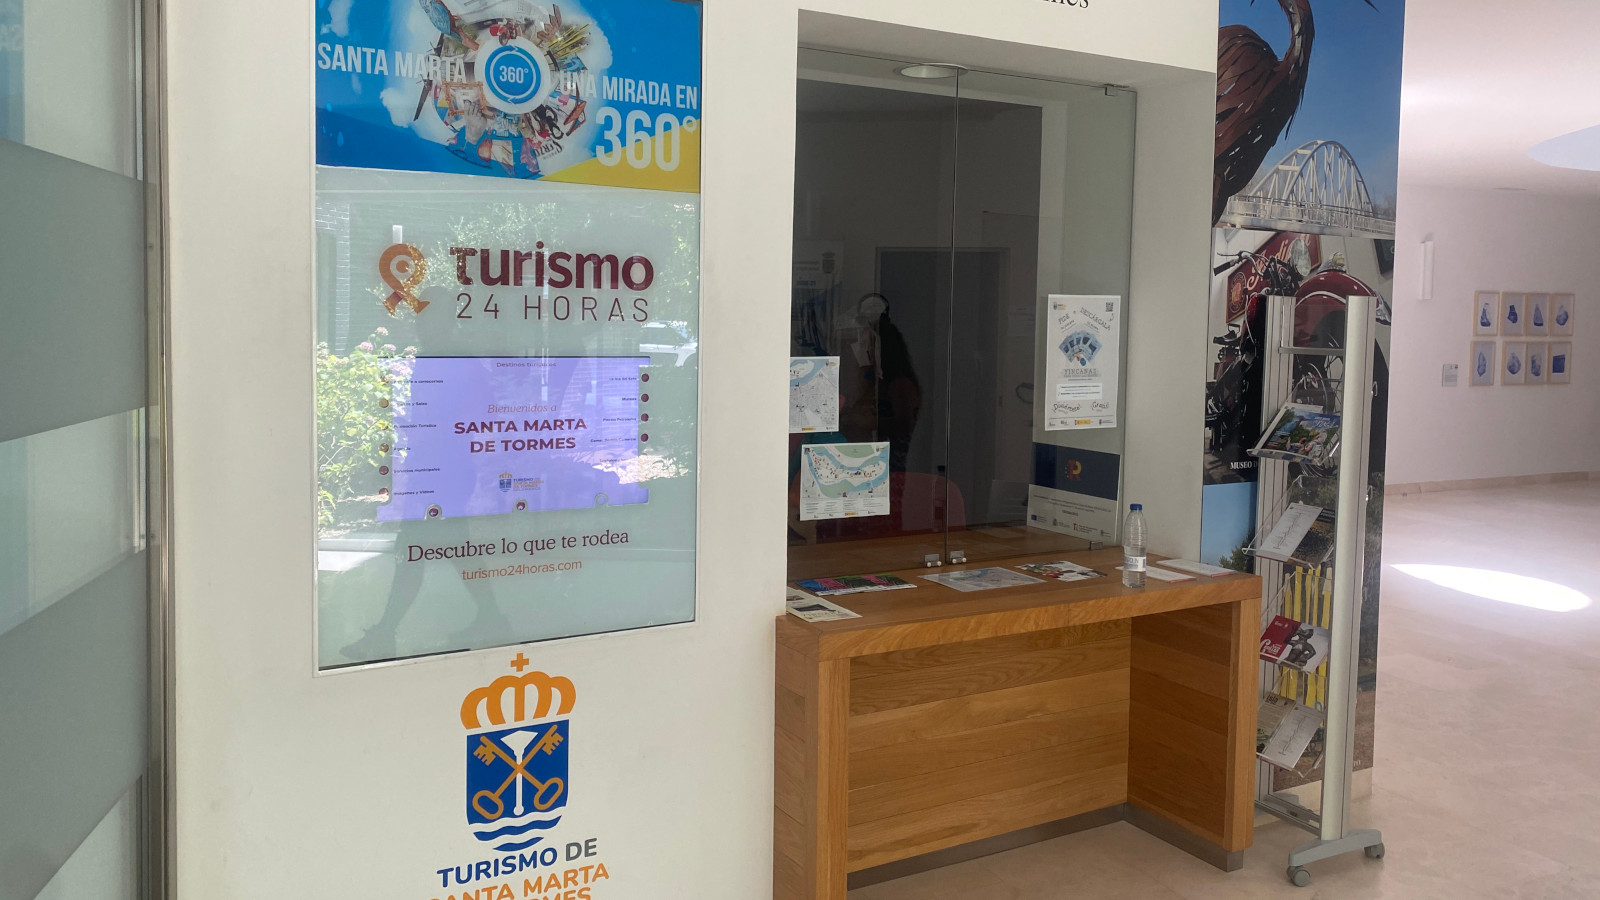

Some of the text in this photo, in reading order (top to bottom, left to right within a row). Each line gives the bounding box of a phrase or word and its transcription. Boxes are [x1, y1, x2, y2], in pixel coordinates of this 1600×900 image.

[317, 42, 466, 82] SANTA MARTA
[499, 65, 530, 84] 360°
[558, 69, 699, 110] UNA MIRADA EN
[595, 107, 699, 172] 360°
[450, 240, 654, 291] turismo
[456, 292, 649, 323] 24 HORAS
[487, 404, 548, 414] Bienvenidos
[454, 418, 587, 434] SANTA MARTA
[470, 437, 576, 453] DE TORMES
[1229, 460, 1253, 470] MUSEO
[407, 529, 629, 562] Descubre lo que te rodea
[462, 559, 582, 581] turismo24horas.com
[436, 838, 598, 888] TURISMO DE
[428, 883, 515, 900] NTA
[523, 863, 610, 897] MARTA
